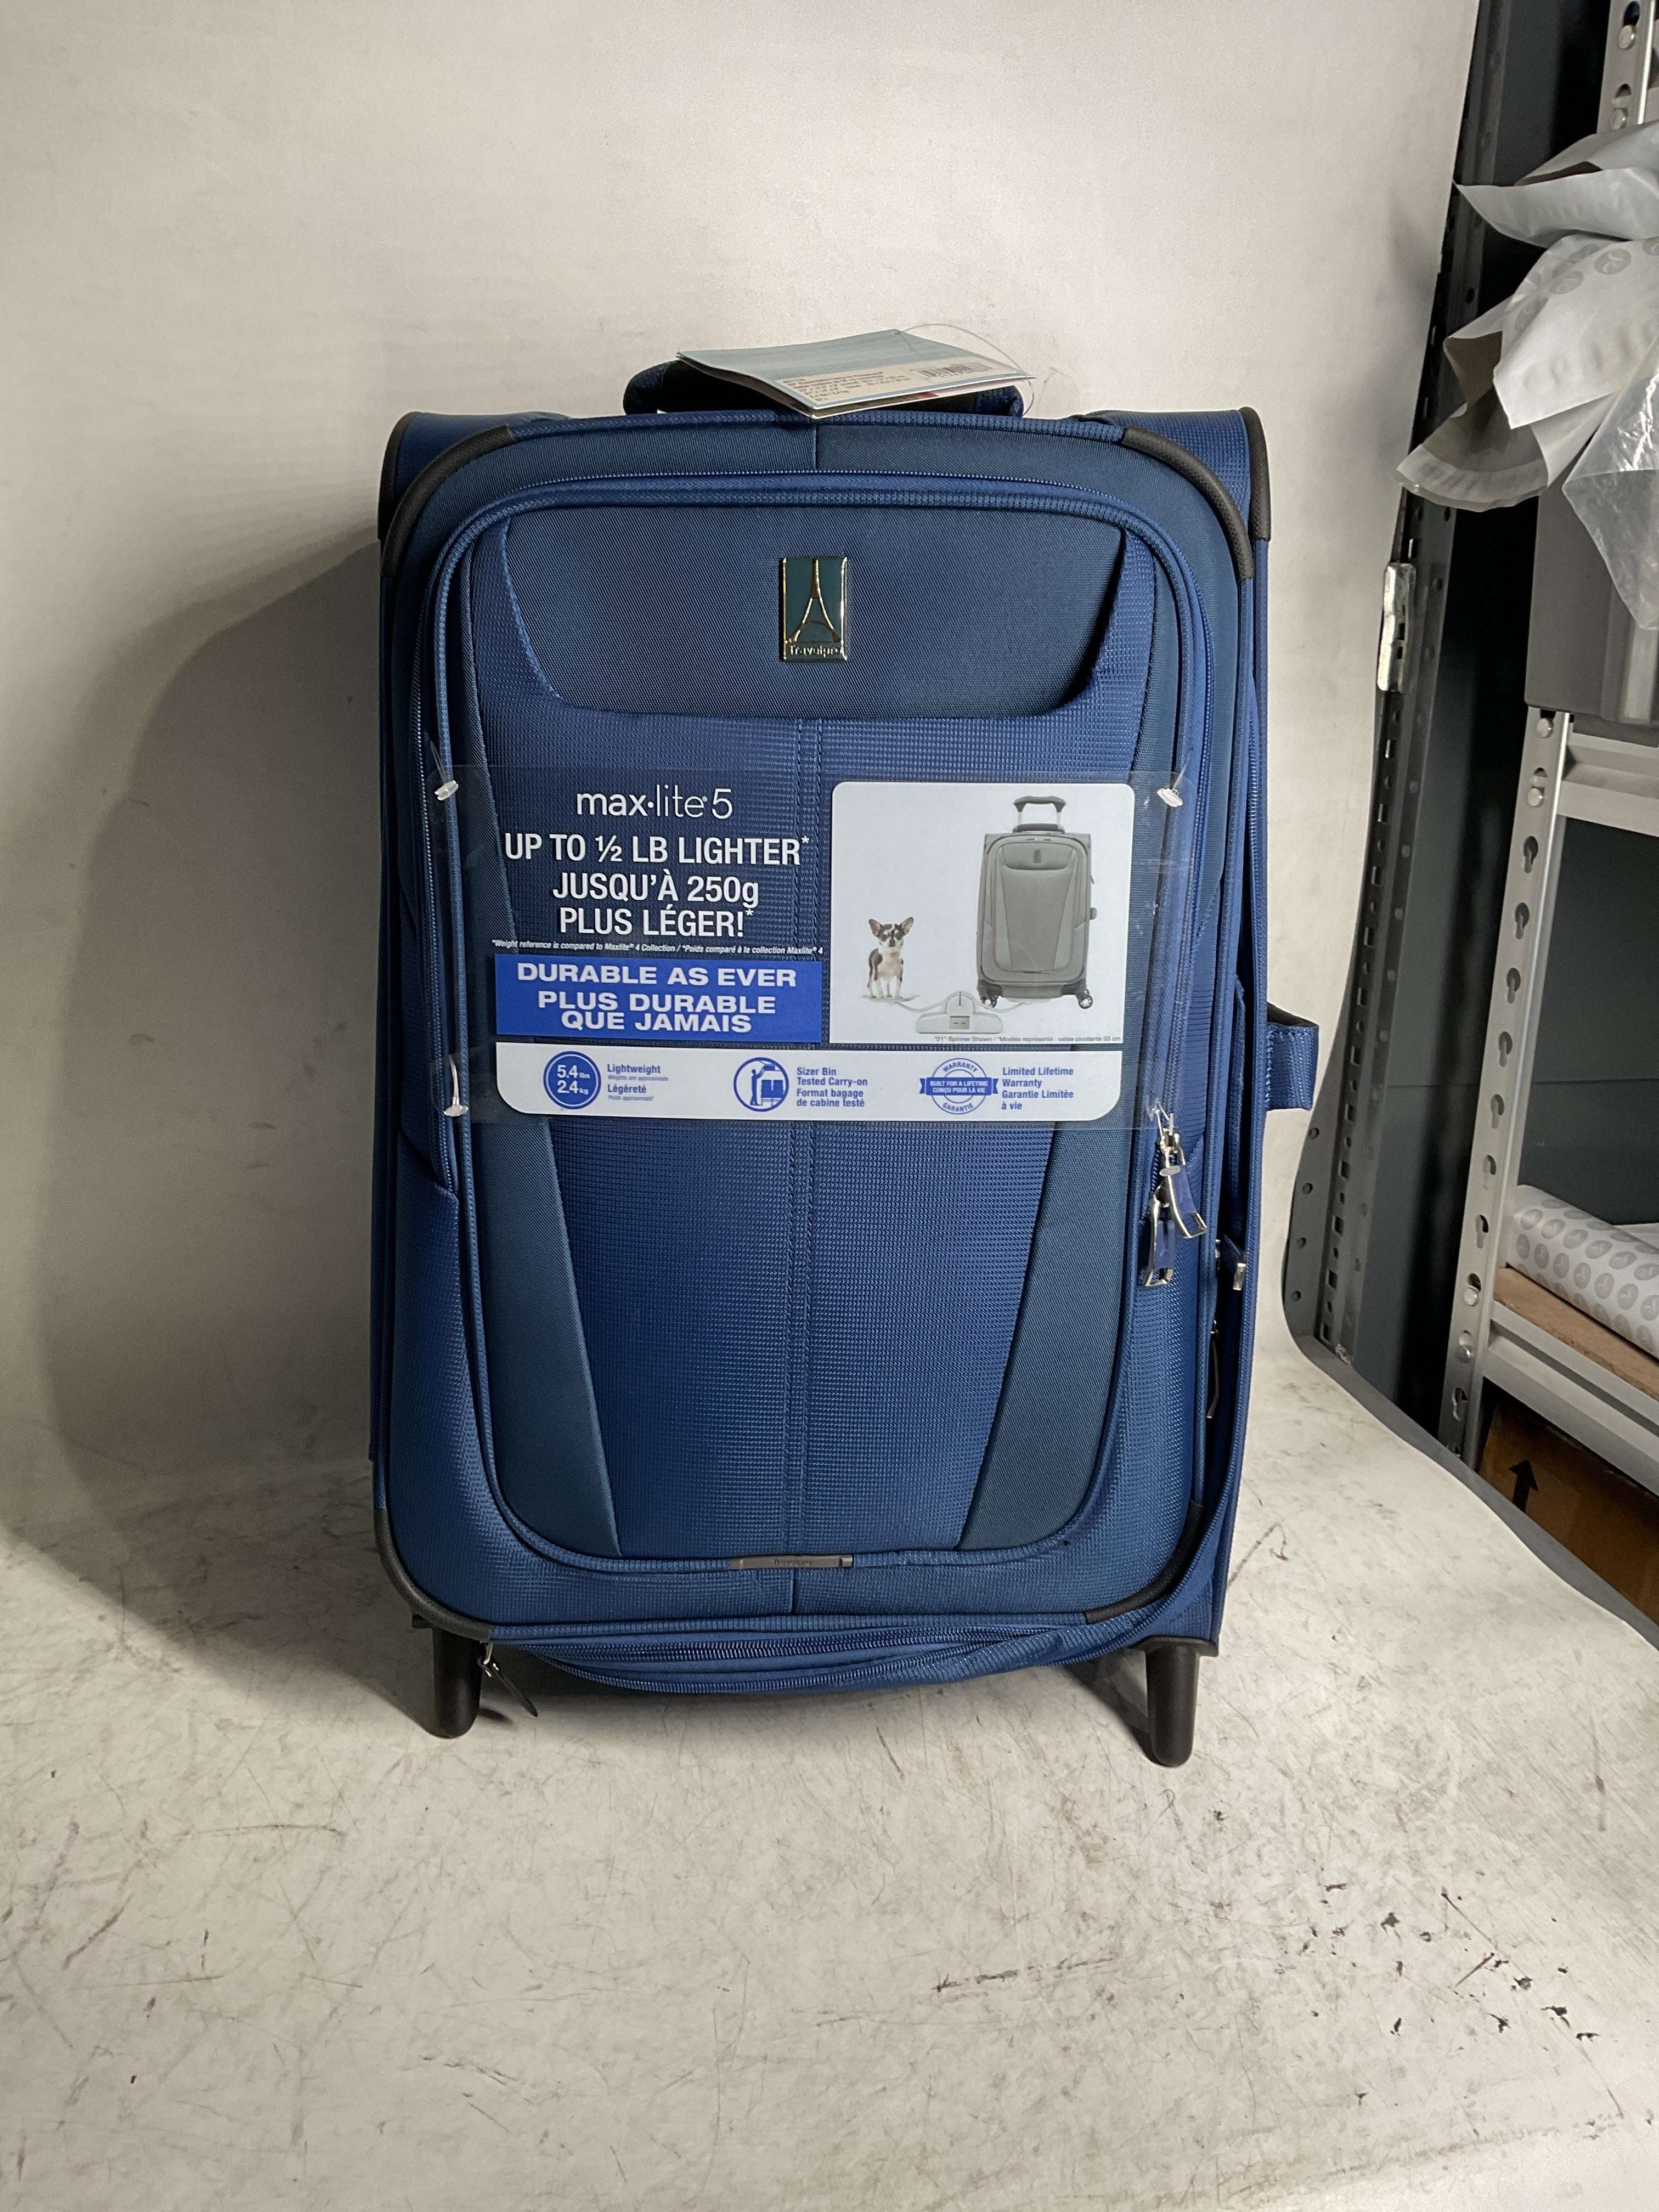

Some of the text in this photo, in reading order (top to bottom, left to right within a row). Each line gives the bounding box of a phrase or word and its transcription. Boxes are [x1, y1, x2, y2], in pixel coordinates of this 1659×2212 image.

[712, 788, 733, 820] 5
[504, 833, 543, 860] UP
[549, 834, 586, 861] TO
[633, 837, 668, 863] LB
[687, 876, 759, 909] 250g
[559, 907, 632, 935] PLUS
[519, 940, 551, 949] reference
[553, 940, 560, 949] is
[560, 942, 594, 951] compared
[596, 942, 603, 950] to
[641, 944, 676, 952] Collection
[706, 945, 736, 955] comparé
[517, 962, 797, 987] DURABLE AS EVER
[538, 991, 776, 1014] PLUS DURABLE
[561, 1011, 752, 1033] QUE JAMAIS
[556, 1064, 578, 1079] 5.4
[607, 1064, 661, 1074] Lightweight
[797, 1067, 837, 1076] Sizer Bin
[943, 1062, 978, 1073] WARRANTY
[1003, 1067, 1074, 1075] Limited Lifetime
[556, 1080, 579, 1094] 2.4
[797, 1077, 868, 1087] Tested Carry-on
[1002, 1079, 1042, 1088] Warranty
[607, 1084, 647, 1094] Légèreté
[797, 1088, 864, 1099] Format bagage
[1002, 1090, 1074, 1098] Garantie Limitée
[797, 1098, 865, 1107] de cabine testé
[943, 1102, 974, 1112] GARANTIE
[1001, 1102, 1022, 1110] à vie
